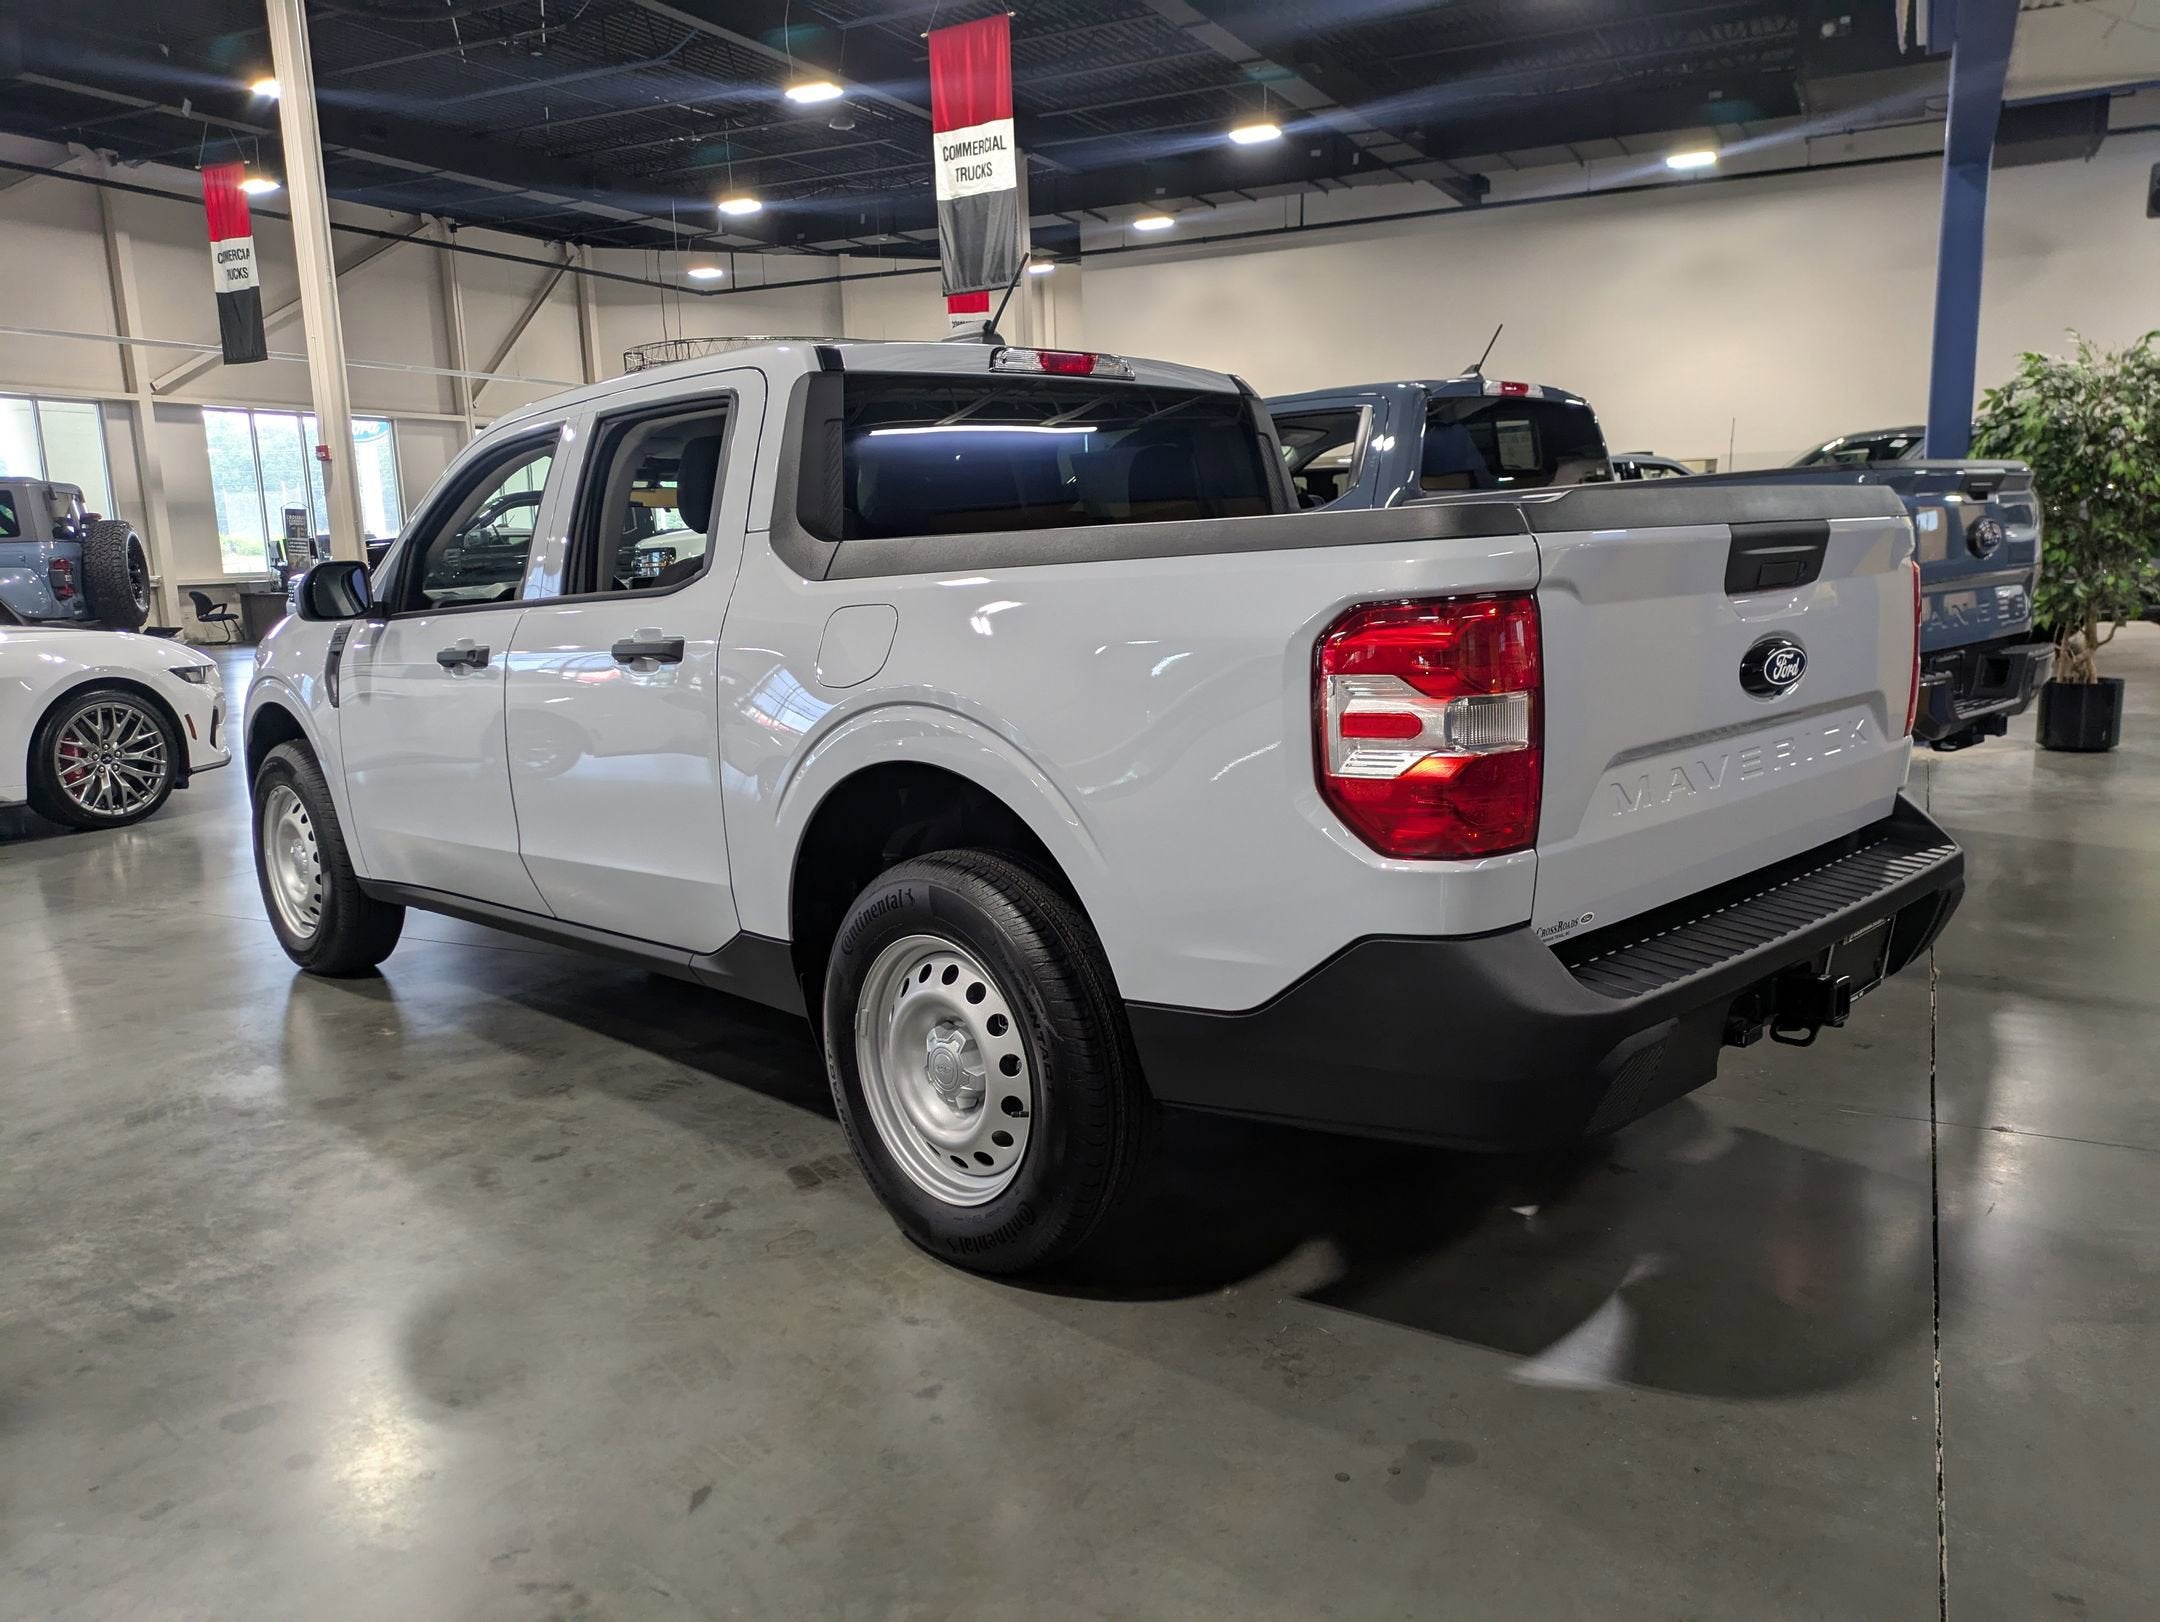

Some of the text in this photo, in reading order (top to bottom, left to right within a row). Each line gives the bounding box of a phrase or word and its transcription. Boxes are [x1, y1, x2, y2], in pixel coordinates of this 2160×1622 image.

[942, 135, 1007, 162] COMMERCIAL
[955, 161, 993, 183] TRUCKS
[1926, 595, 2027, 632] ANGER
[1773, 652, 1800, 680] Ford
[1609, 717, 1868, 817] MAVERICK
[841, 888, 904, 955] Continental
[960, 1201, 1035, 1255] Continental
